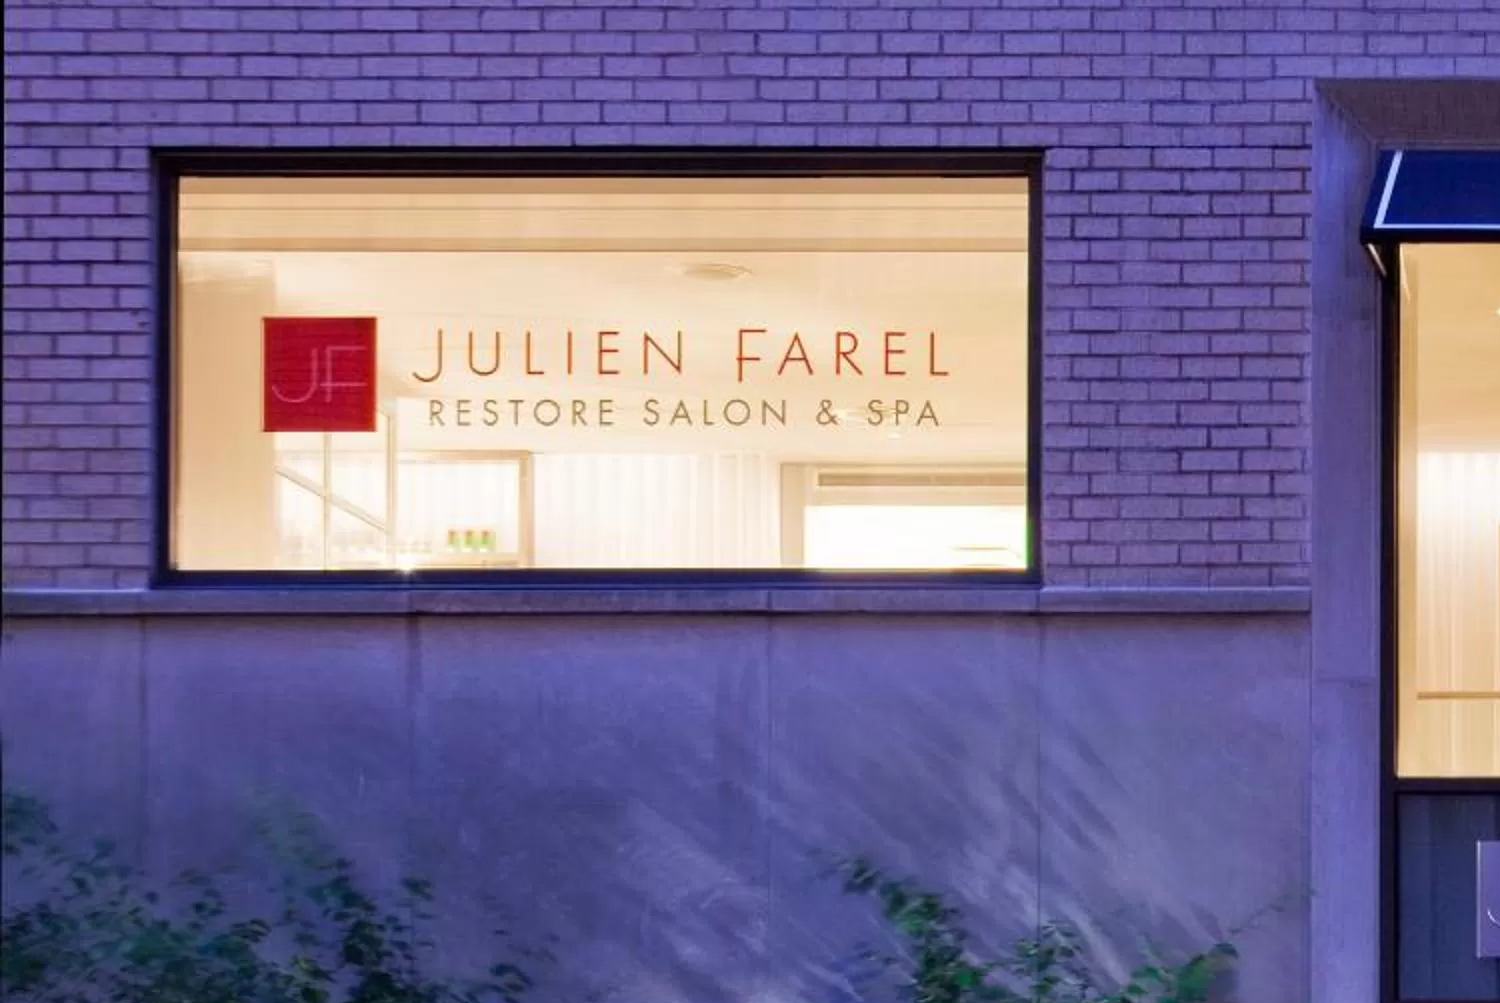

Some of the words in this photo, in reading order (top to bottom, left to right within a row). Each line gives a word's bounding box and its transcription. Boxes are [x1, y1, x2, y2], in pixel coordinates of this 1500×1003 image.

[272, 346, 368, 403] JF
[412, 328, 683, 383] JULIEN
[736, 328, 949, 383] FAREL
[428, 399, 617, 427] RESTORE
[642, 398, 788, 427] SALON
[815, 398, 840, 427] &
[866, 398, 941, 427] SPA
